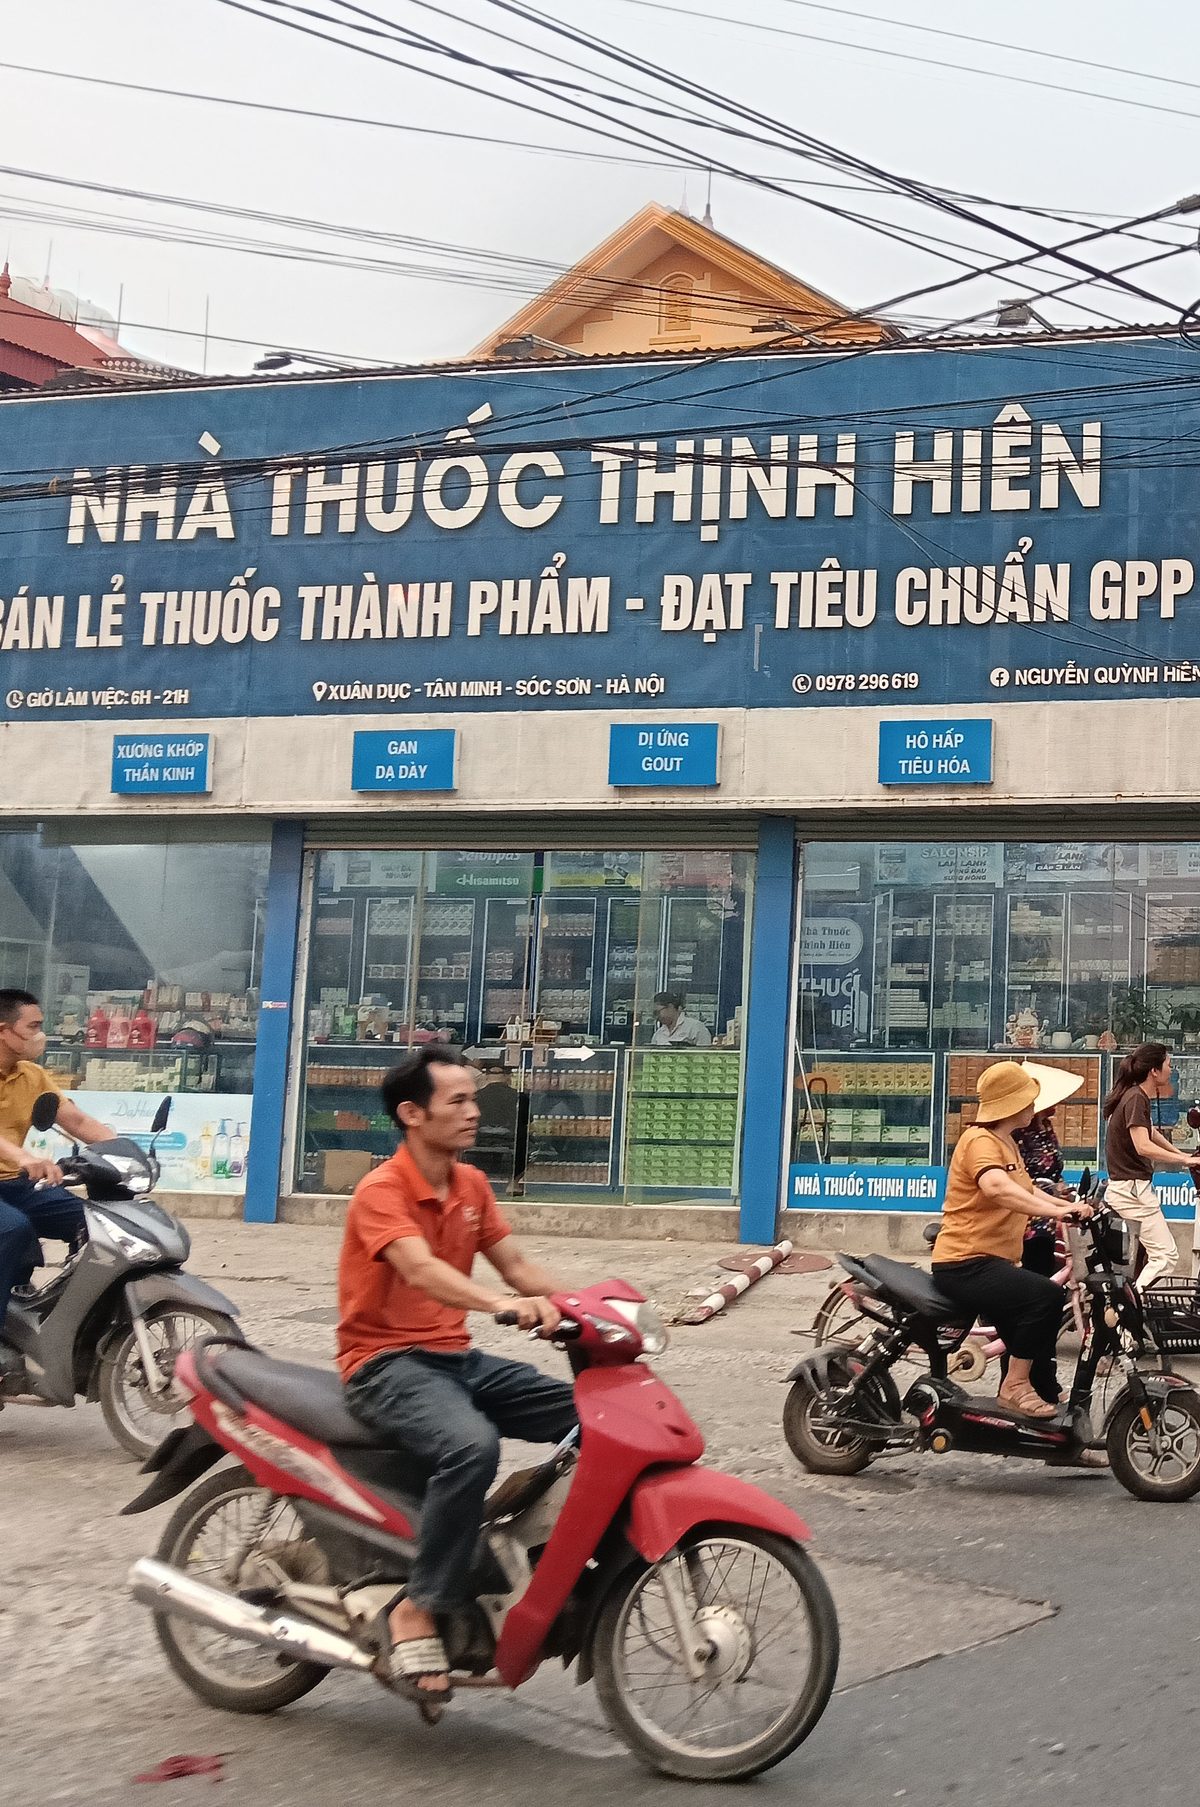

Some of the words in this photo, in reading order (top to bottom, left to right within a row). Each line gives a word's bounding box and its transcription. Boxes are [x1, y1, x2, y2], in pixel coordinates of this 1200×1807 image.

[67, 431, 235, 544] NHÀ
[265, 403, 564, 535] THUỐC
[592, 432, 856, 541] THỊNH
[894, 403, 1101, 514] HIÊN
[0, 586, 64, 650] ÁN
[75, 574, 126, 648] LẺ
[140, 568, 281, 645] THUỐC
[298, 572, 453, 640] THÀNH
[468, 552, 610, 635] PHẨM
[625, 597, 644, 610] -
[661, 572, 752, 642] ĐẠT
[771, 558, 877, 629] TIÊU
[895, 536, 1070, 626] CHUẨN
[1089, 558, 1194, 621] GPP
[815, 674, 855, 691] 0978
[859, 673, 888, 690] 296
[891, 672, 919, 689] 619
[1015, 660, 1089, 687] NGUYỄN
[1094, 663, 1159, 687] QUỲNH
[26, 687, 54, 708] GIỜ
[55, 687, 88, 707] LÀM
[91, 686, 130, 709] VIỆC:
[131, 689, 153, 705] 6H
[162, 689, 190, 705] 21H
[328, 680, 373, 701] XUÂN
[376, 682, 411, 704] DỤC
[424, 678, 457, 697] TÂN
[460, 680, 502, 697] MINH
[515, 675, 551, 696] SÓC
[555, 678, 591, 696] SƠN
[606, 675, 631, 695] HÀ
[639, 673, 666, 697] NỘI
[387, 741, 418, 755] GAN
[638, 732, 654, 749] DỊ
[656, 727, 690, 747] ỨNG
[906, 730, 929, 749] HÔ
[932, 727, 964, 748] HẤP
[117, 744, 163, 759] XƯƠNG
[167, 740, 205, 757] KHỚP
[124, 763, 159, 782] THẦN
[163, 767, 195, 781] KINH
[375, 765, 396, 781] DẠ
[398, 761, 428, 780] DÀY
[641, 757, 684, 772] GOUT
[898, 755, 934, 775] TIÊU
[937, 755, 971, 773] HÓA
[794, 1172, 821, 1196] NHÀ
[823, 1171, 864, 1197] THUỐC
[867, 1177, 905, 1201] THỊNH
[907, 1175, 937, 1198] HIÊN
[1155, 1180, 1198, 1207] THUỐC
